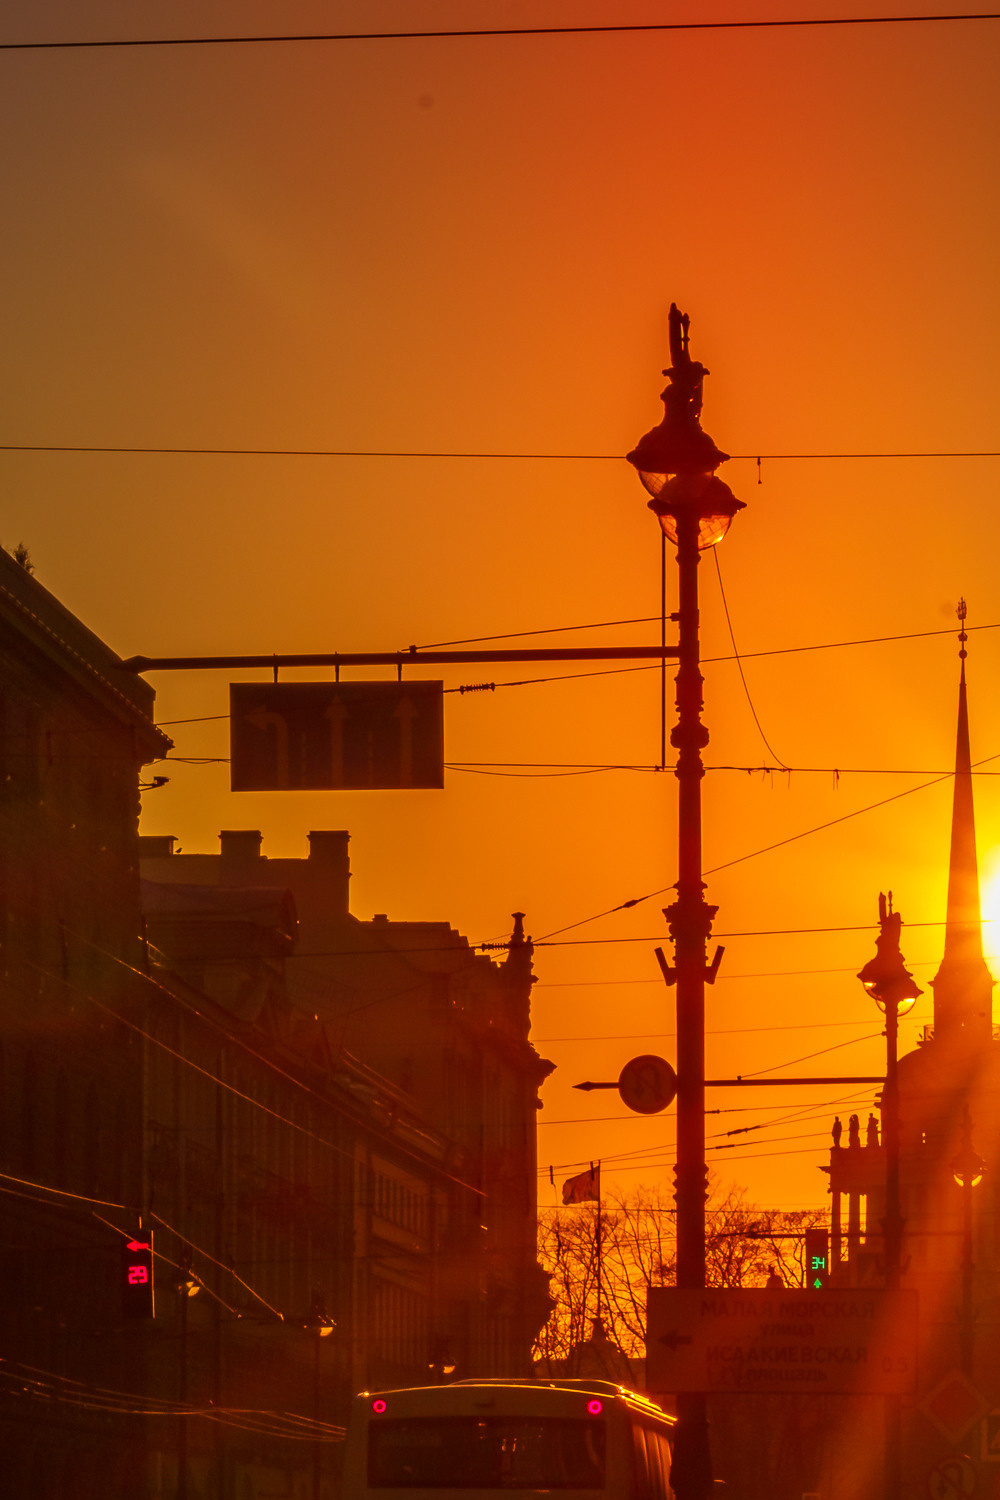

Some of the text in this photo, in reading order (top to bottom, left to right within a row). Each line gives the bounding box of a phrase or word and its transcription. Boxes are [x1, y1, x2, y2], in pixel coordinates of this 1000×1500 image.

[811, 1256, 826, 1270] 34
[128, 1265, 148, 1285] 29
[700, 1299, 876, 1319] МАЛАЯ МОРСКАЯ
[759, 1323, 815, 1338] улица
[706, 1345, 869, 1364] ИСААКИЕВСКАЯ
[746, 1367, 828, 1382] площадь
